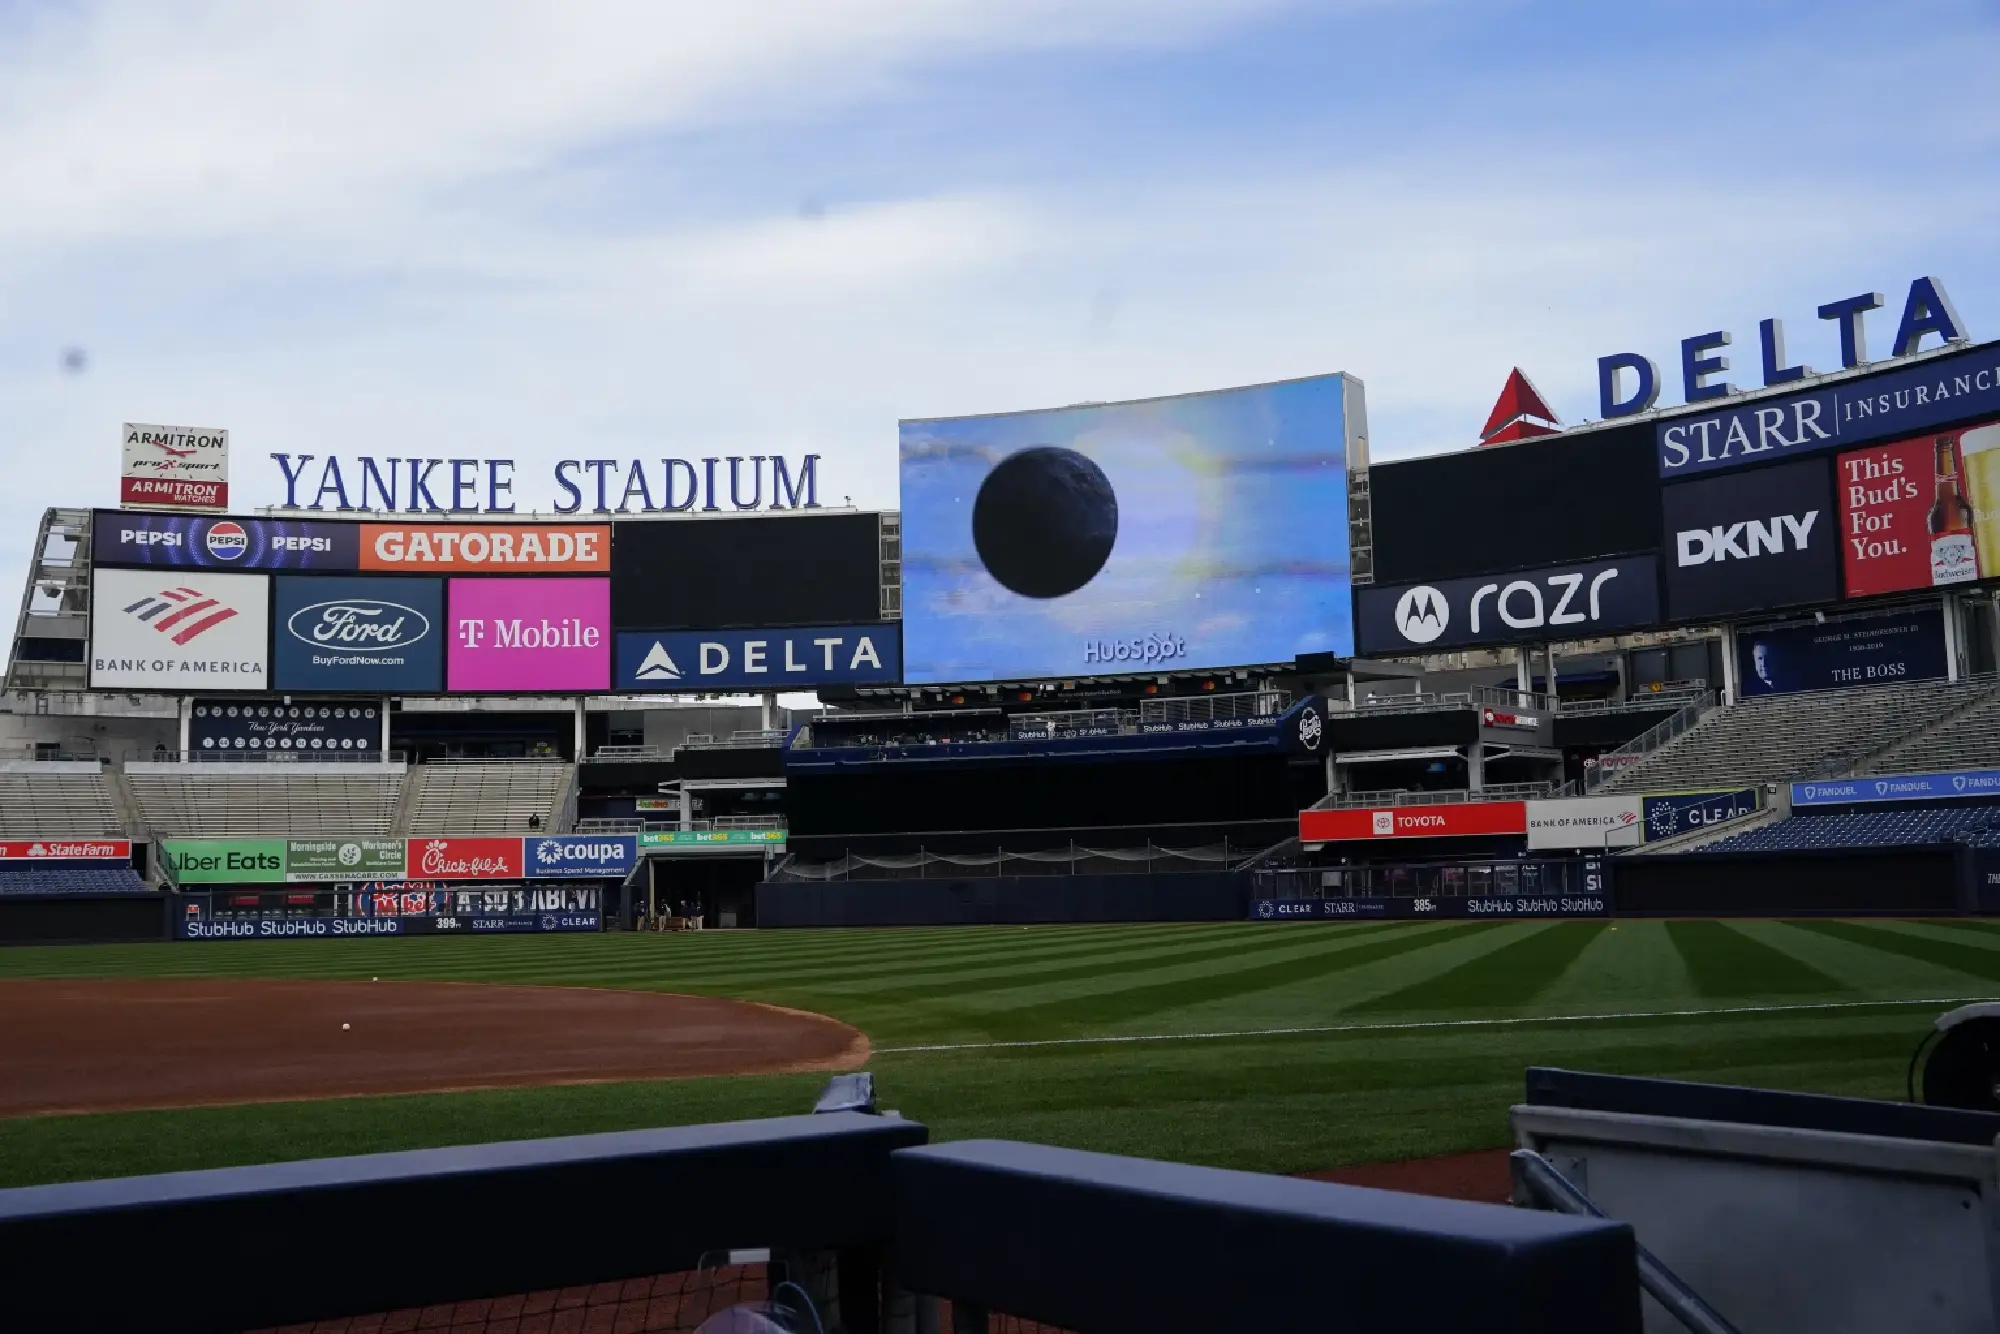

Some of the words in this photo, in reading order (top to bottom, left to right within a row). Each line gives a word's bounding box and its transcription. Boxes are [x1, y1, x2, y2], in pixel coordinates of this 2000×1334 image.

[1597, 276, 1971, 419] DELTA
[127, 432, 224, 448] ARMITRON
[1664, 399, 1832, 468] STARR
[1845, 453, 1904, 483] This
[131, 481, 217, 495] ARMITRON
[270, 453, 516, 513] YANKEE
[554, 453, 821, 512] STADIUM
[174, 494, 216, 504] WATCHES
[1849, 477, 1918, 509] Bud's
[1850, 511, 1893, 535] For
[121, 530, 182, 546] PEPSI
[209, 536, 245, 546] PEPSI
[271, 537, 331, 551] PEPSI
[1677, 510, 1819, 568] DKNY
[374, 532, 598, 562] GATORADE
[1851, 537, 1908, 560] You.
[1470, 568, 1619, 633] razr
[313, 606, 405, 642] Ford
[459, 619, 484, 648] T
[493, 618, 600, 648] Mobile
[700, 636, 882, 675] DELTA
[1084, 633, 1185, 664] HubSpot
[95, 658, 146, 671] BANK
[151, 659, 174, 672] OF
[180, 660, 262, 673] AMERICA
[312, 655, 405, 666] BuyFordNow.com
[1831, 667, 1862, 681] THE
[1867, 662, 1906, 678] BOSS
[267, 721, 289, 735] York
[290, 721, 325, 736] Yankees
[1178, 722, 1208, 730] StubHub
[1213, 719, 1243, 728] StubHub
[1818, 786, 1858, 797] FANDUEL
[1890, 782, 1933, 792] FANDUEL
[1397, 816, 1446, 828] TOYOTA
[1530, 818, 1555, 828] BANK
[1558, 818, 1571, 826] OF
[1572, 816, 1615, 826] AMERICA
[643, 834, 675, 842] bet365
[696, 833, 728, 841] bet365
[750, 832, 782, 840] bet365
[290, 841, 337, 853] Morningside
[361, 840, 402, 850] Workmen's
[379, 850, 402, 860] Circle
[563, 843, 625, 864] coupa
[227, 852, 280, 870] Eats
[422, 847, 509, 875] Chick-fil-A
[584, 867, 625, 875] Management
[1278, 904, 1312, 913] CLEAR
[1324, 902, 1356, 913] STARR
[1467, 900, 1513, 913] StubHub
[1516, 899, 1558, 912] StubHub
[1561, 898, 1604, 911] StubHub
[260, 920, 326, 935] StubHub
[332, 919, 397, 933] StubHub
[472, 920, 505, 929] STARR
[561, 917, 597, 926] CLEAR
[187, 921, 254, 937] StubHub
